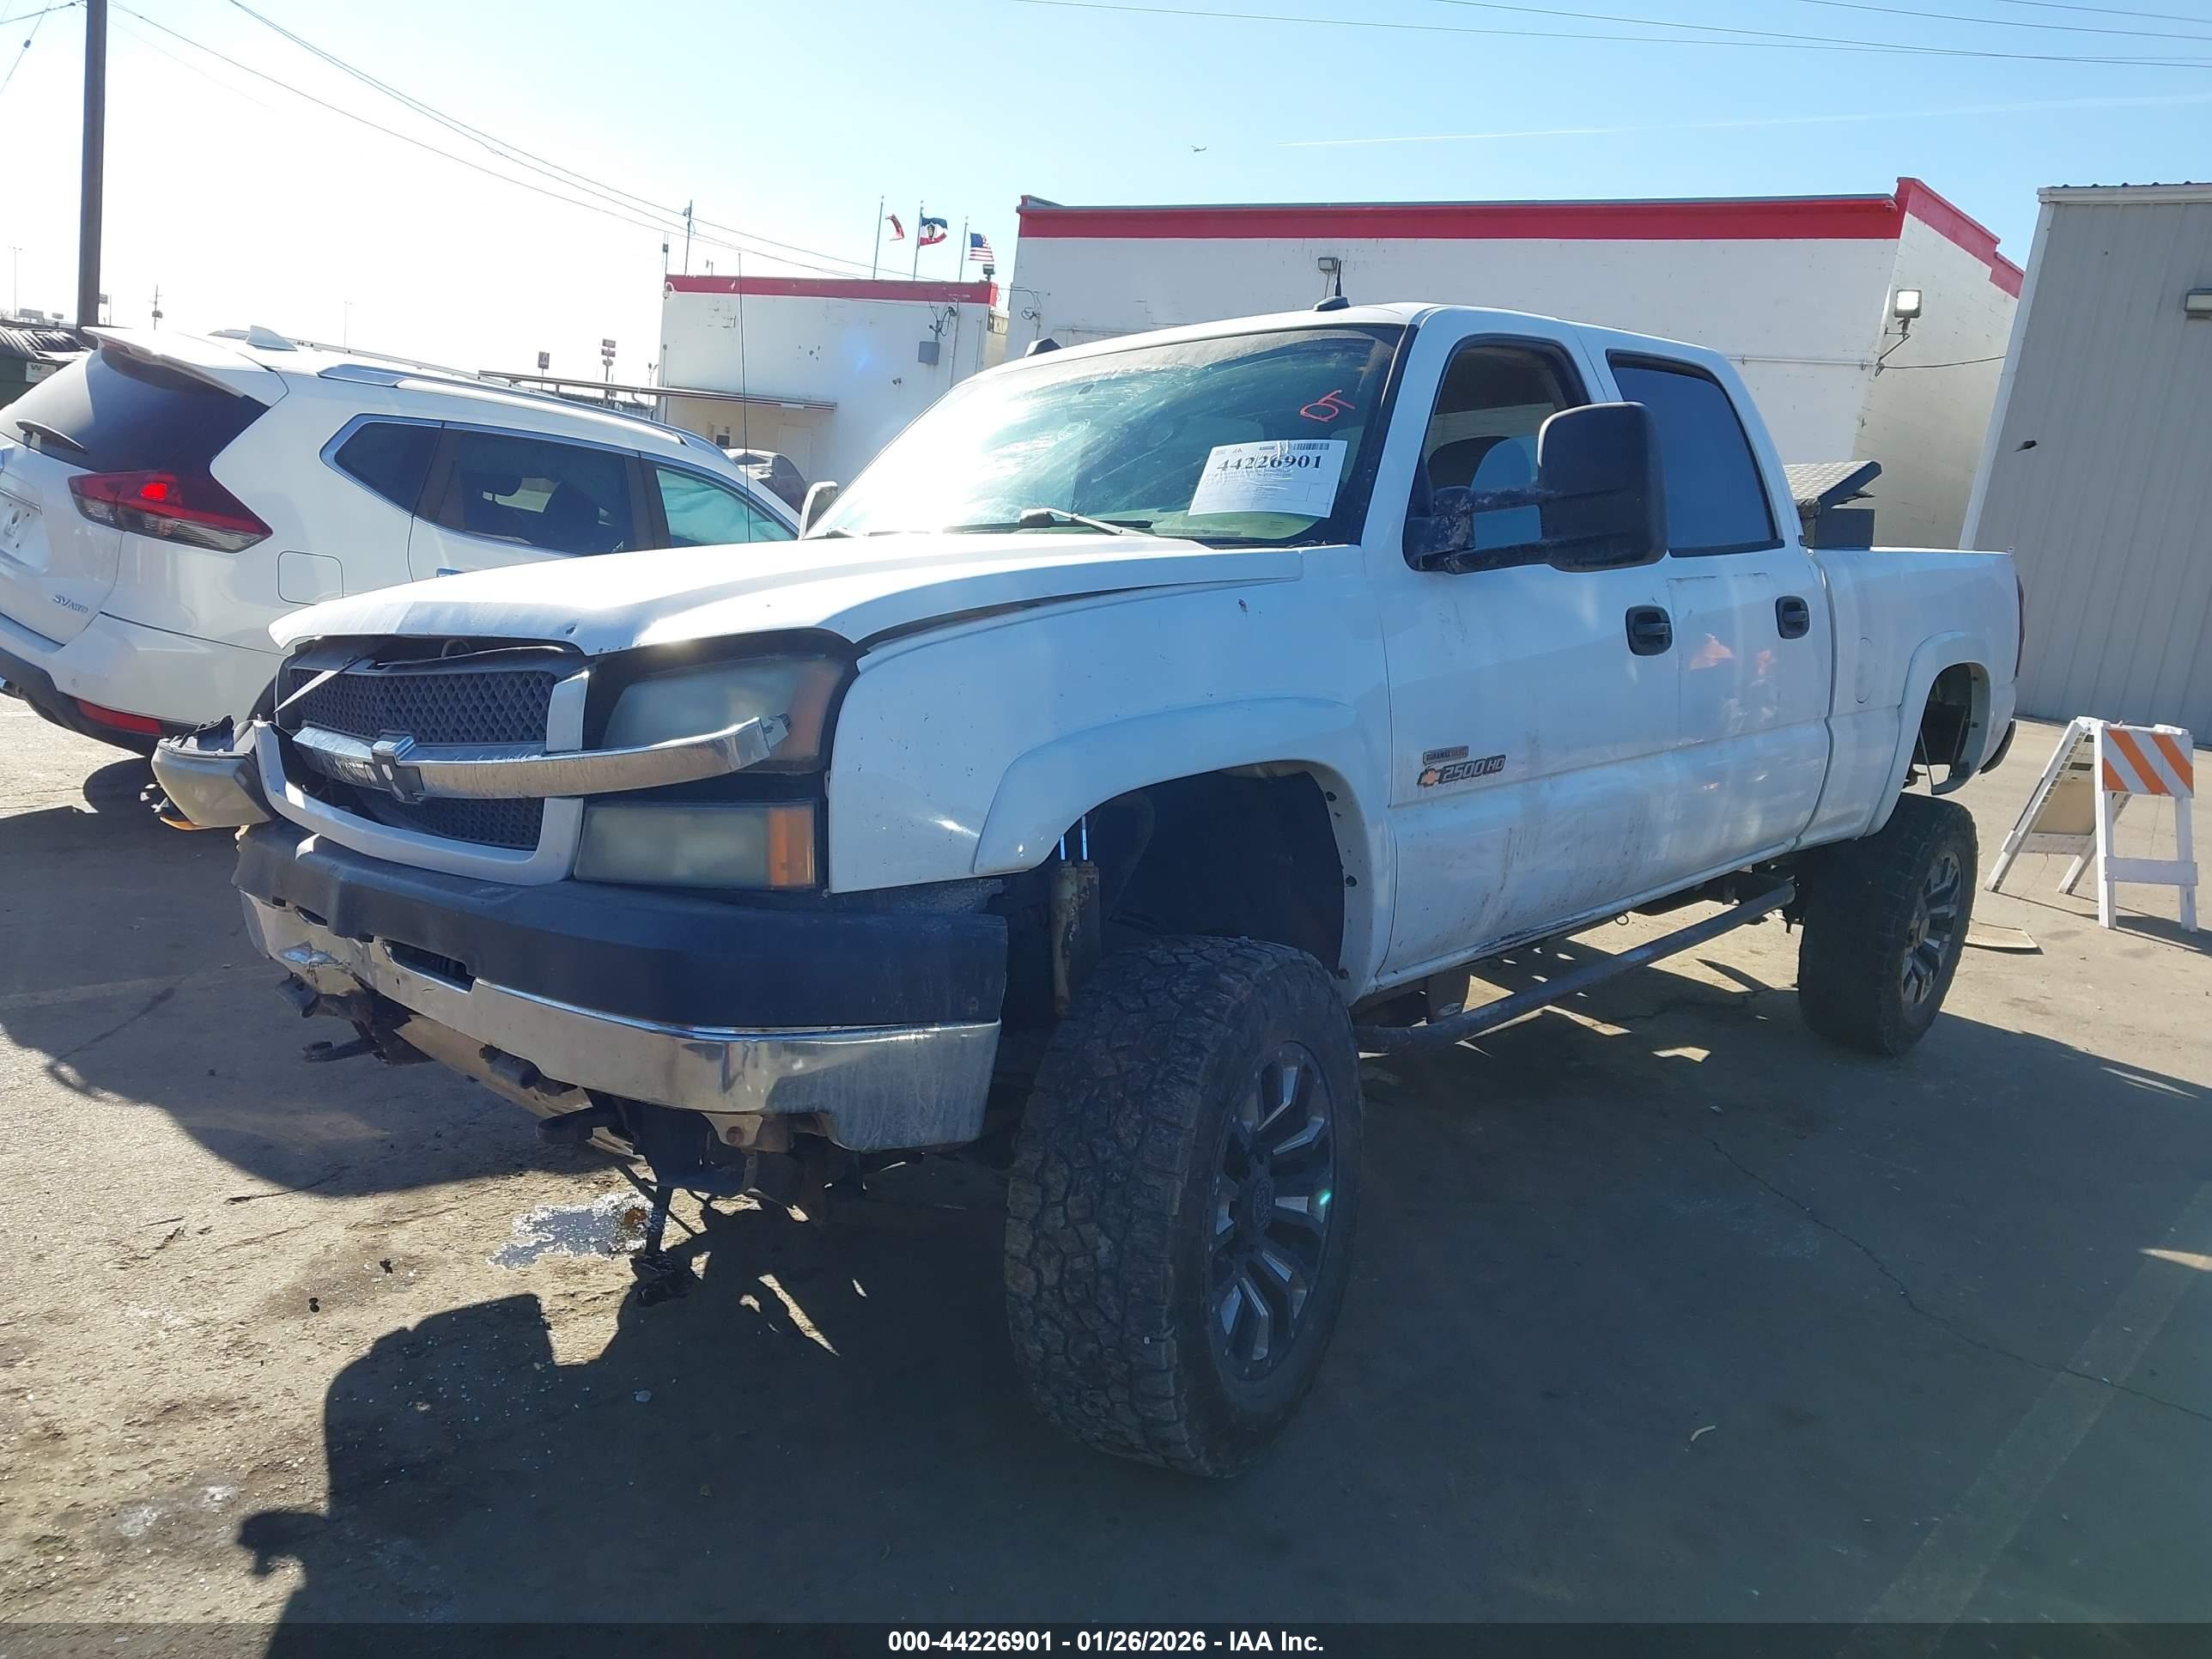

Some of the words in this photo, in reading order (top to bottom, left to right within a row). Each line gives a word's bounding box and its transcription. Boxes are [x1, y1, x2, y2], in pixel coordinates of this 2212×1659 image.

[1216, 455, 1322, 471] 44226901
[52, 593, 71, 605] SV
[1443, 758, 1486, 782] 2500
[1486, 757, 1505, 771] HD
